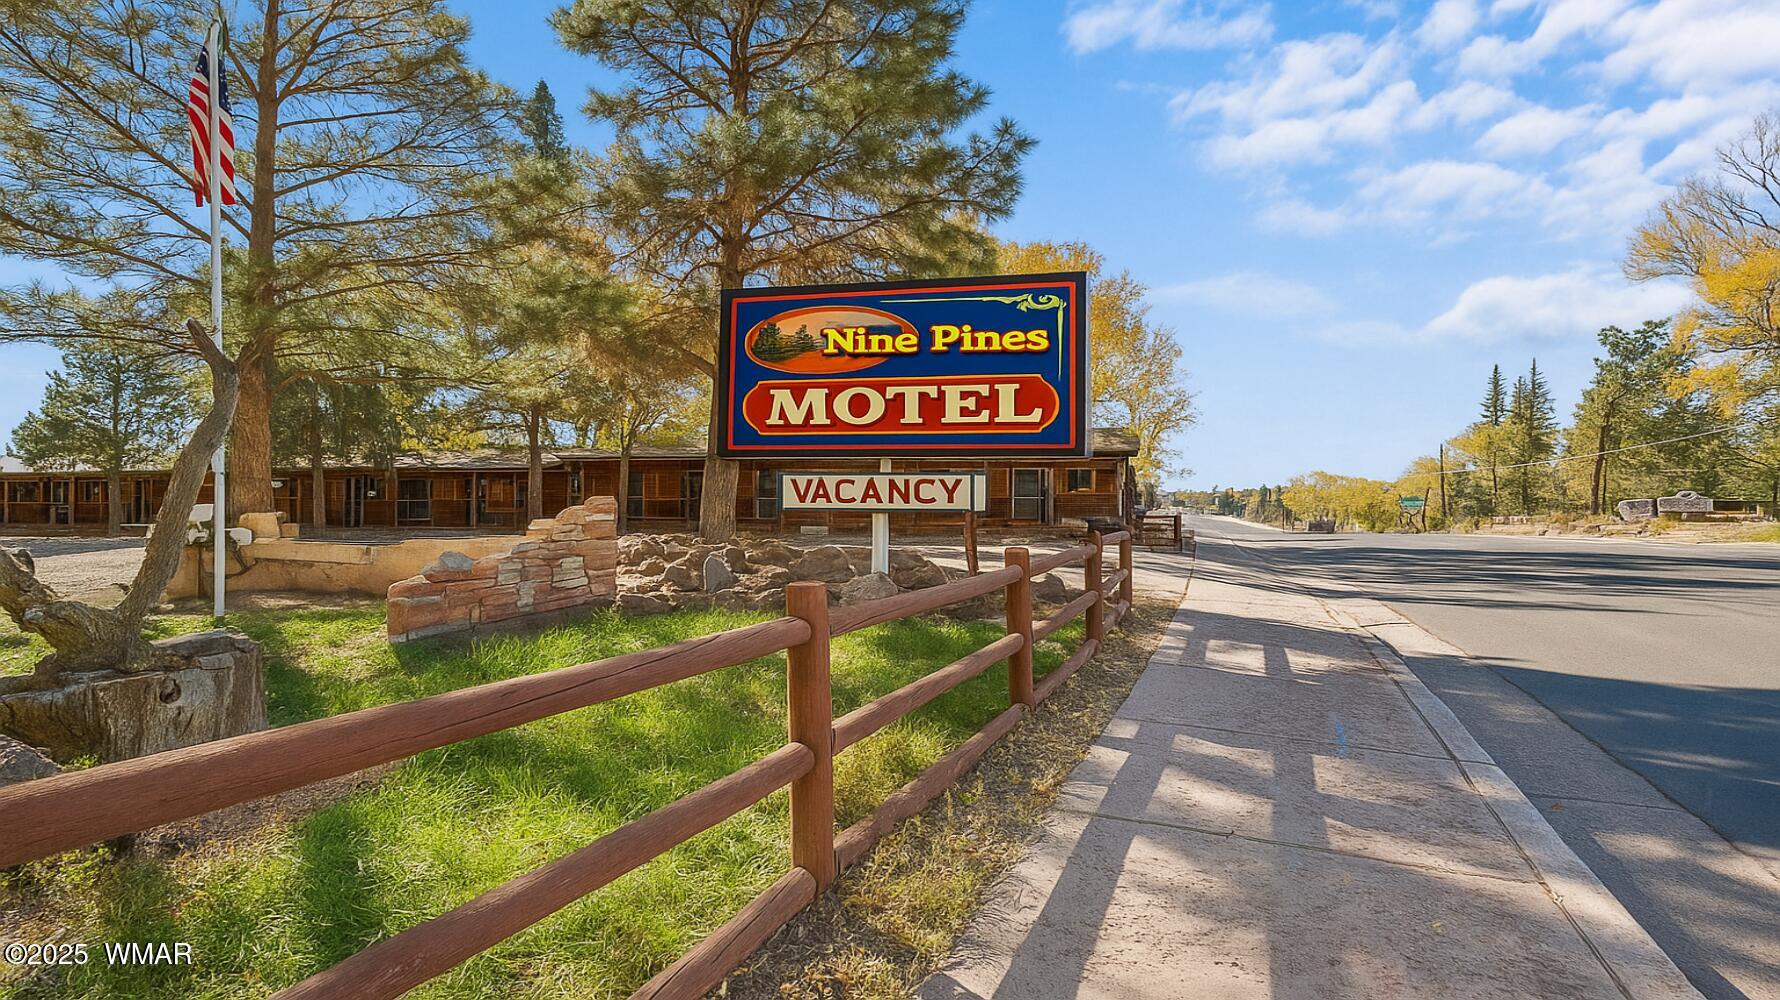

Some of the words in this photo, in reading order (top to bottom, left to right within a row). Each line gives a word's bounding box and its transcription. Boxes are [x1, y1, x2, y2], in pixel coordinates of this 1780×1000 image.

[823, 327, 918, 354] Nine
[931, 324, 1049, 351] Pines
[765, 383, 1043, 425] MOTEL
[790, 477, 963, 505] VACANCY
